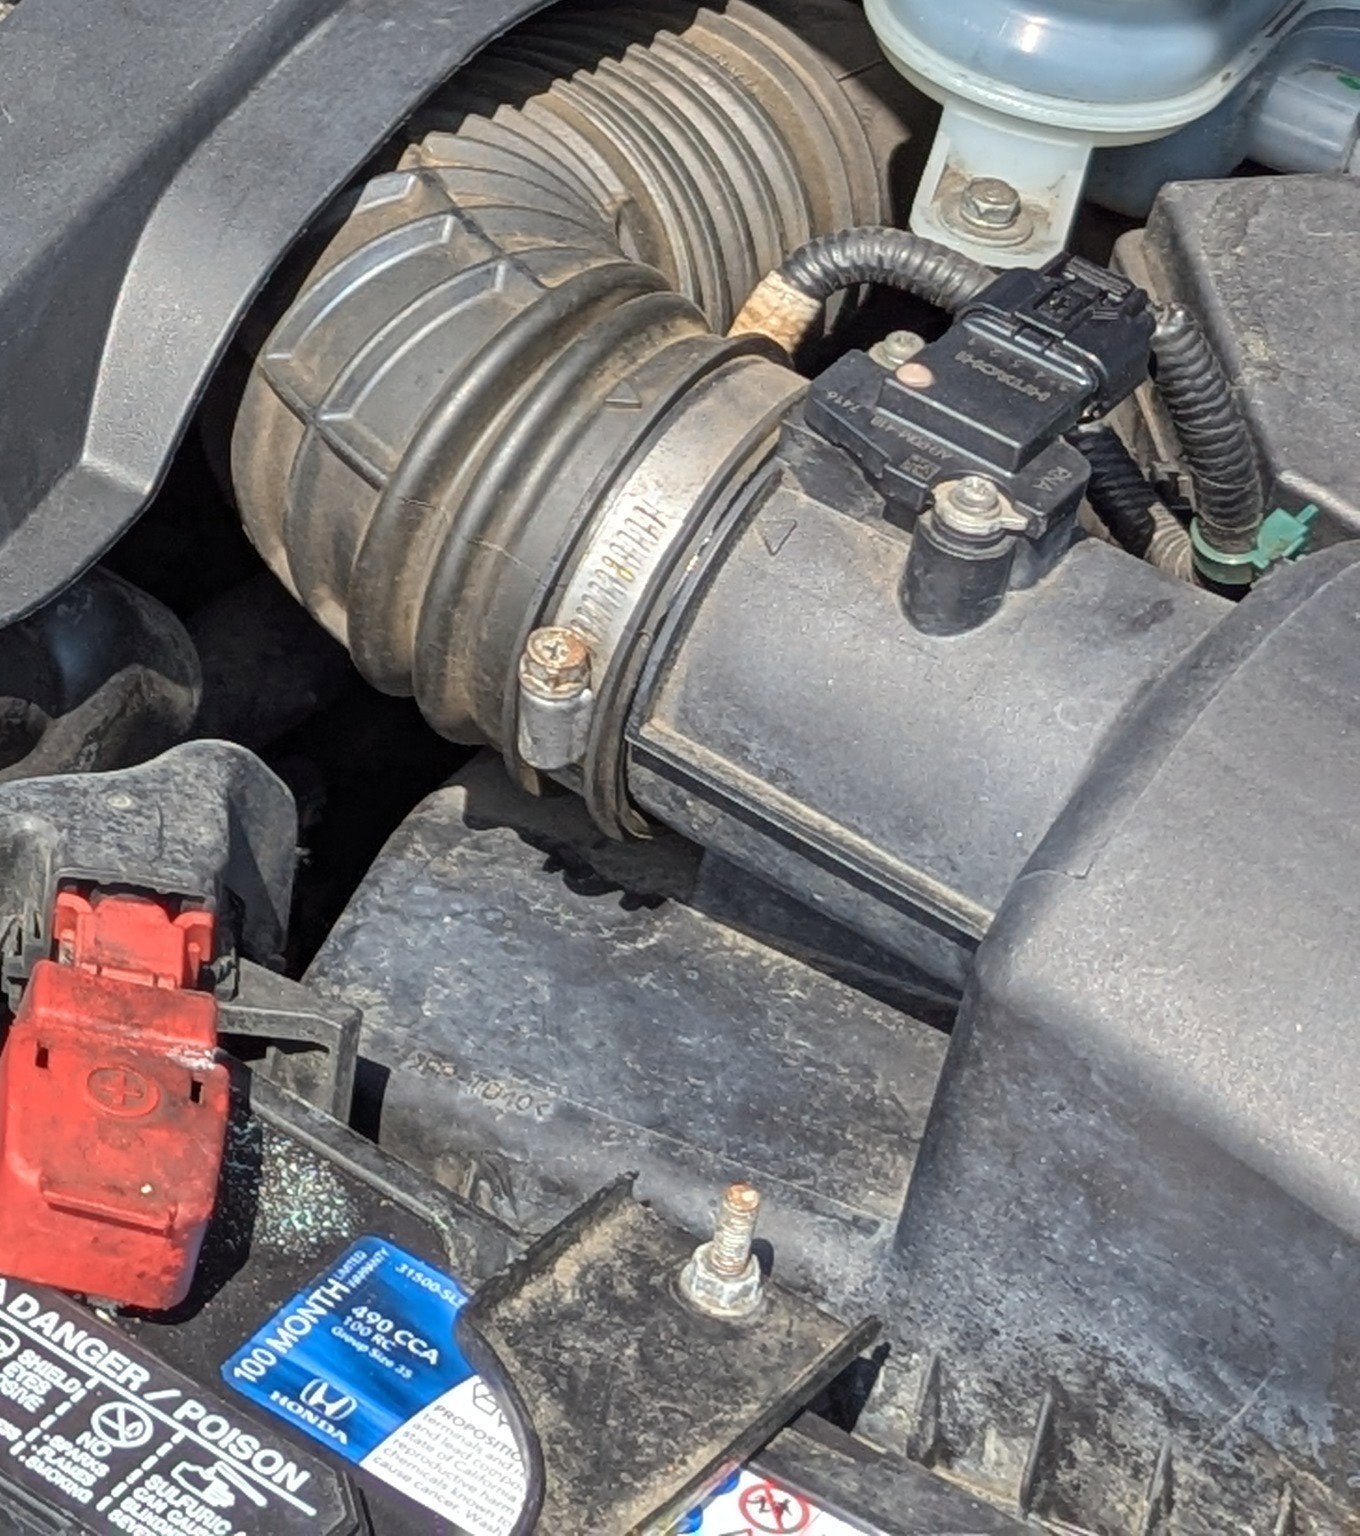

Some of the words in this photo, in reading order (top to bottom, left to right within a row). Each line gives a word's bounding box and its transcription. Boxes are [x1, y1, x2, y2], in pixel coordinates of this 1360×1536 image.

[233, 1344, 278, 1383] 100
[265, 1275, 350, 1354] MONTH
[329, 1324, 369, 1355] Group
[366, 1346, 395, 1368] Size
[349, 1302, 394, 1334] 490
[390, 1327, 440, 1366] CCA
[369, 1332, 395, 1352] RC
[1, 1361, 51, 1396] EYES
[5, 1292, 151, 1392] DANGER
[173, 1398, 310, 1494] POISON
[14, 1348, 82, 1396] SHIELD
[268, 1390, 347, 1446] HONDA
[412, 1420, 441, 1441] and
[75, 1431, 113, 1460] NO
[391, 1439, 478, 1494] reproductive
[484, 1450, 513, 1471] and
[372, 1455, 412, 1482] cause
[382, 1445, 449, 1490] chemicals
[450, 1487, 495, 1519] known
[452, 1459, 517, 1503] California
[133, 1487, 168, 1514] CAN
[144, 1474, 232, 1536] SULFURIC
